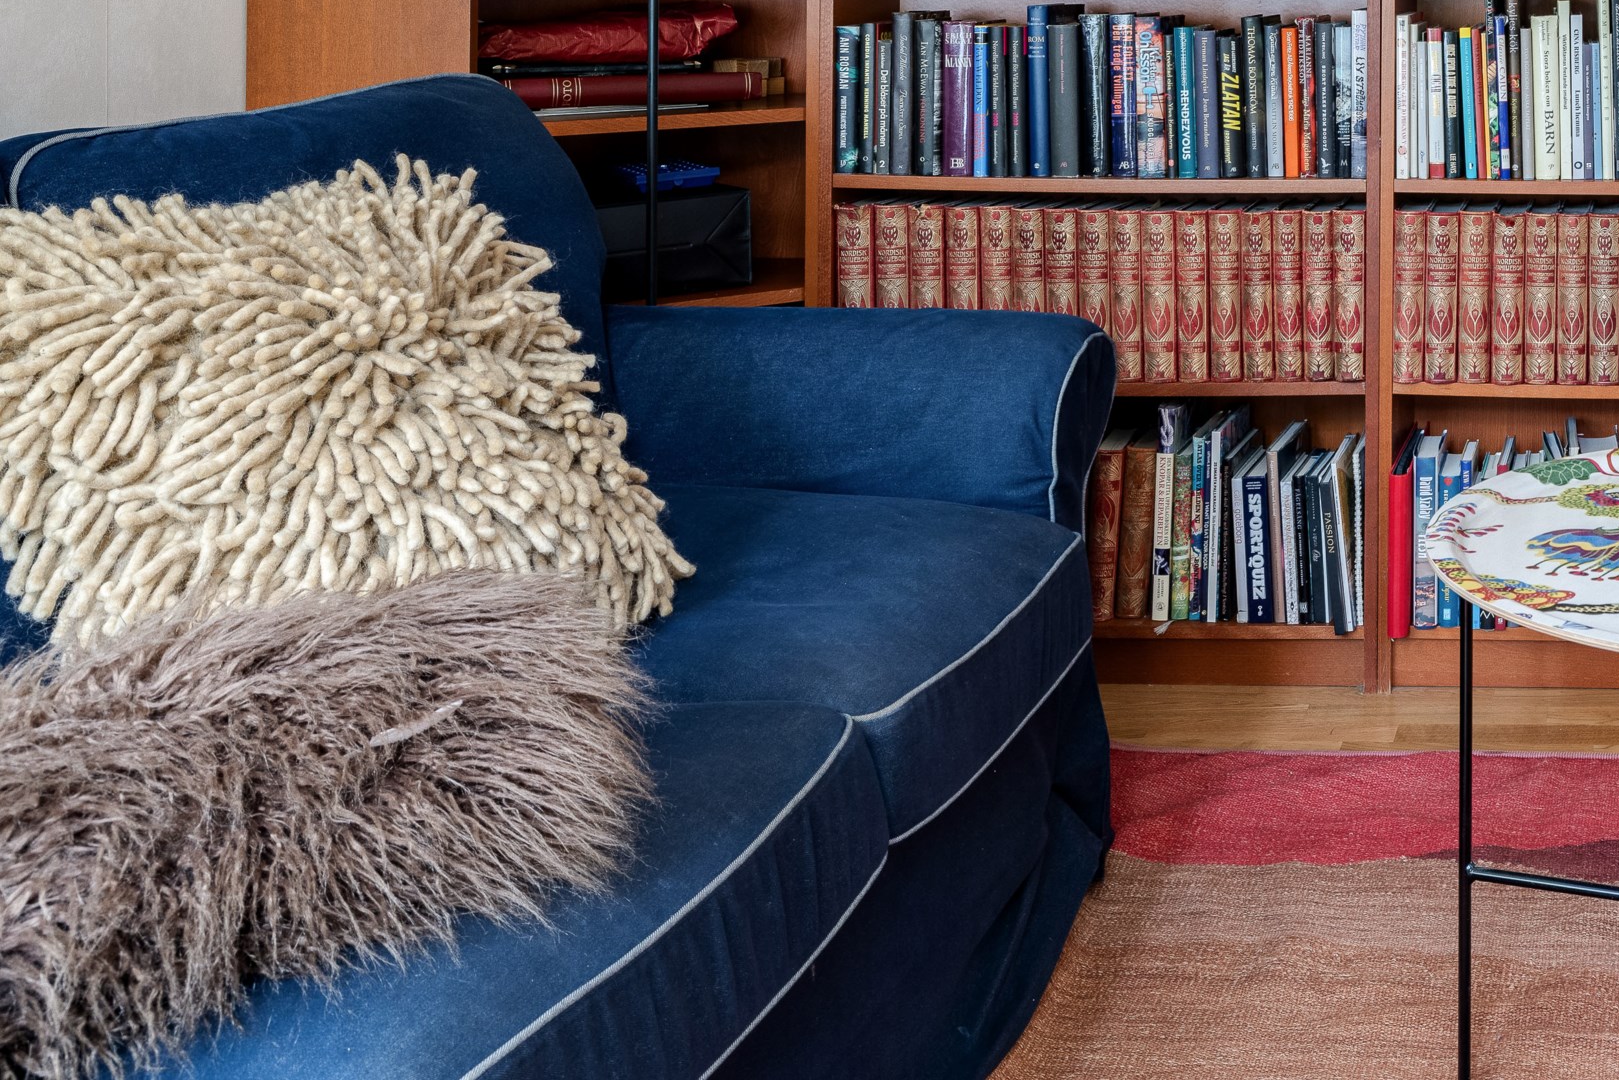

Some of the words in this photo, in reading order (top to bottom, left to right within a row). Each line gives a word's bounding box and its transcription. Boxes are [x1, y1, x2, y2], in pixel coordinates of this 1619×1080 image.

[1508, 2, 1519, 31] kylies
[839, 37, 849, 54] ANN
[1247, 26, 1257, 64] THOMAS
[1508, 34, 1519, 54] kök
[839, 55, 850, 90] ROSMAN
[1543, 50, 1551, 71] Stora
[879, 69, 889, 83] Det
[1201, 64, 1209, 94] Lindqvist
[1248, 66, 1258, 114] BODSTRÖM
[1544, 73, 1552, 94] boken
[880, 84, 889, 107] blåser
[1221, 72, 1241, 131] ZLATAN
[1545, 95, 1551, 107] om
[879, 107, 889, 119] på
[1179, 89, 1191, 160] RENDEZVOUS
[880, 120, 889, 147] månen
[1544, 110, 1556, 155] BARN
[1157, 457, 1166, 489] KNOPAR
[1419, 476, 1433, 497] David
[1157, 497, 1165, 546] REPARBETEN
[1324, 512, 1335, 554] PASSION
[1247, 493, 1266, 600] SPORTQUIZ
